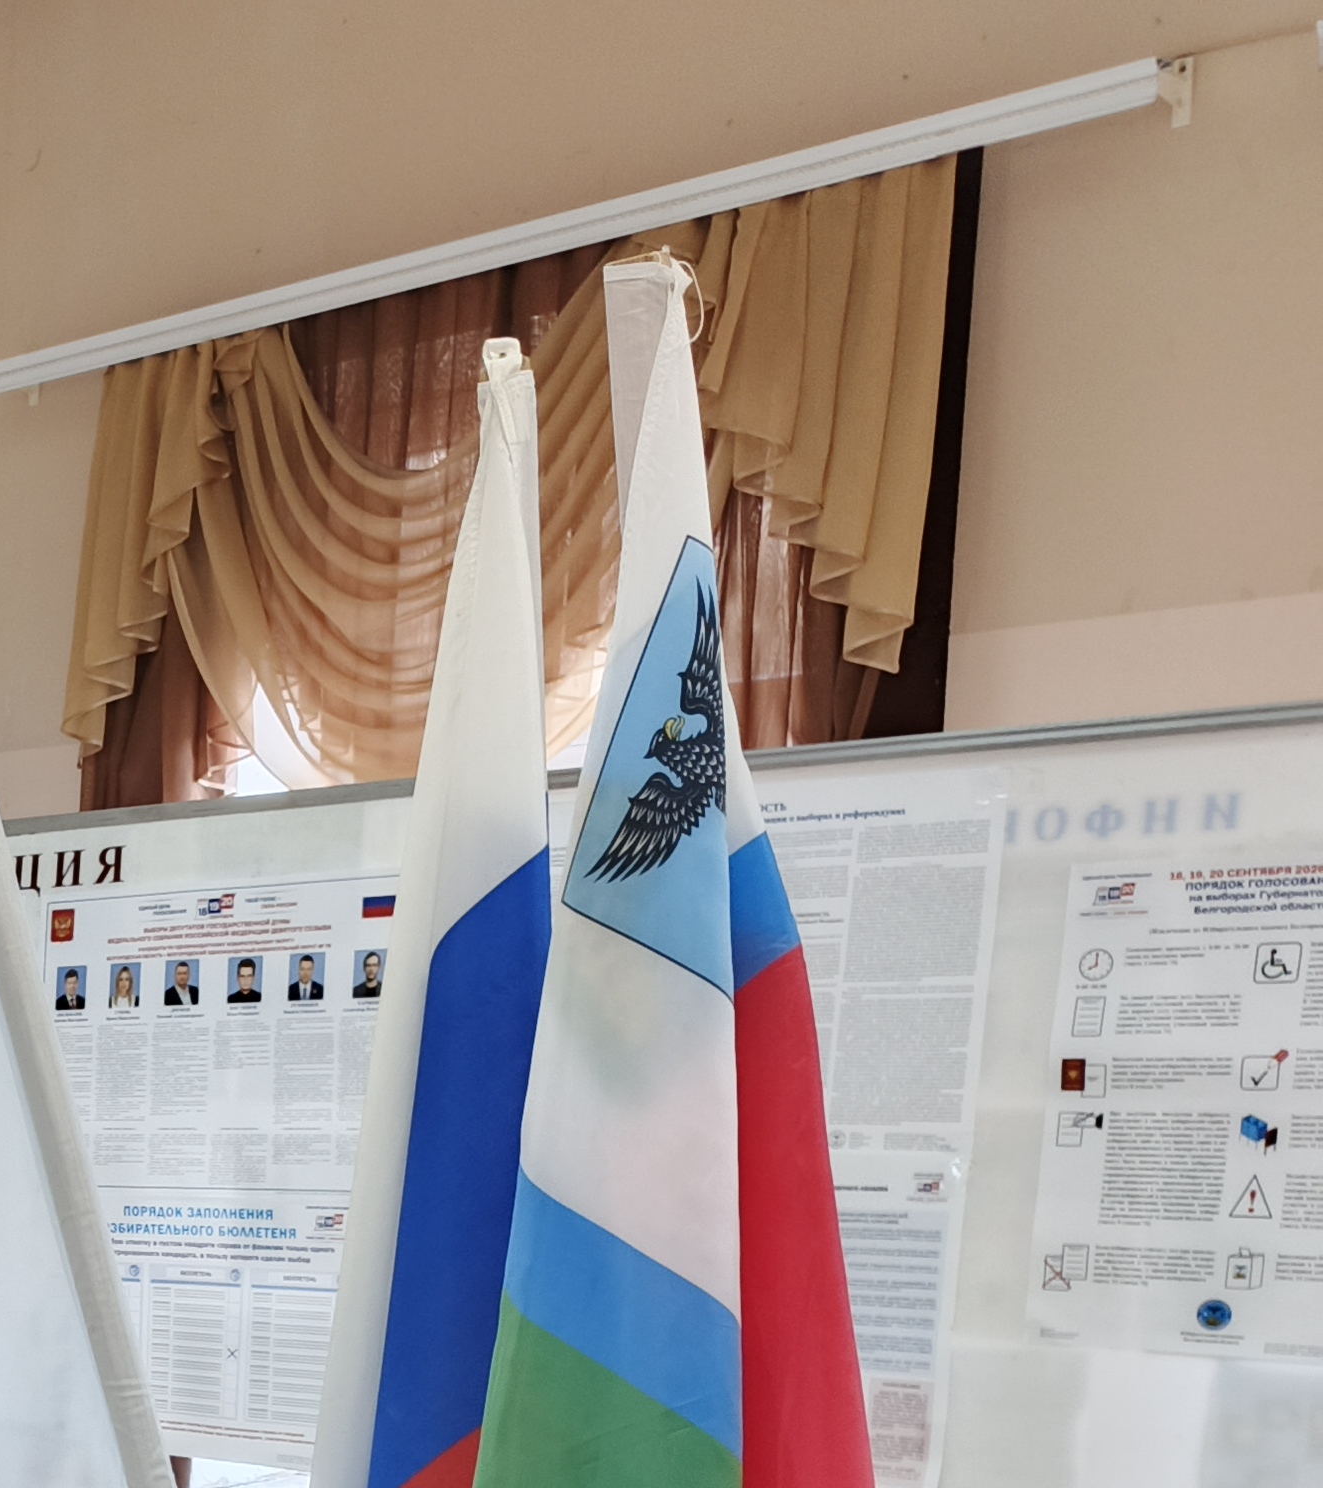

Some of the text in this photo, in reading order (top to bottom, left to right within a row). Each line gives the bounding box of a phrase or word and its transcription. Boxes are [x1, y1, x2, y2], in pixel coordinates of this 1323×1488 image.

[1209, 869, 1224, 878] 20
[1227, 866, 1292, 878] СЕНТЯБРЯ
[1185, 879, 1245, 891] ПОРЯДОК
[1206, 893, 1256, 902] выборах
[1194, 902, 1278, 914] Белгородской
[123, 1205, 274, 1221] ПОРЯДОК ЗАПОЛНЕНИЯ
[107, 1222, 297, 1239] ЗБИРАТЕЛЬНОГО БЮЛЛЕТЕНЯ
